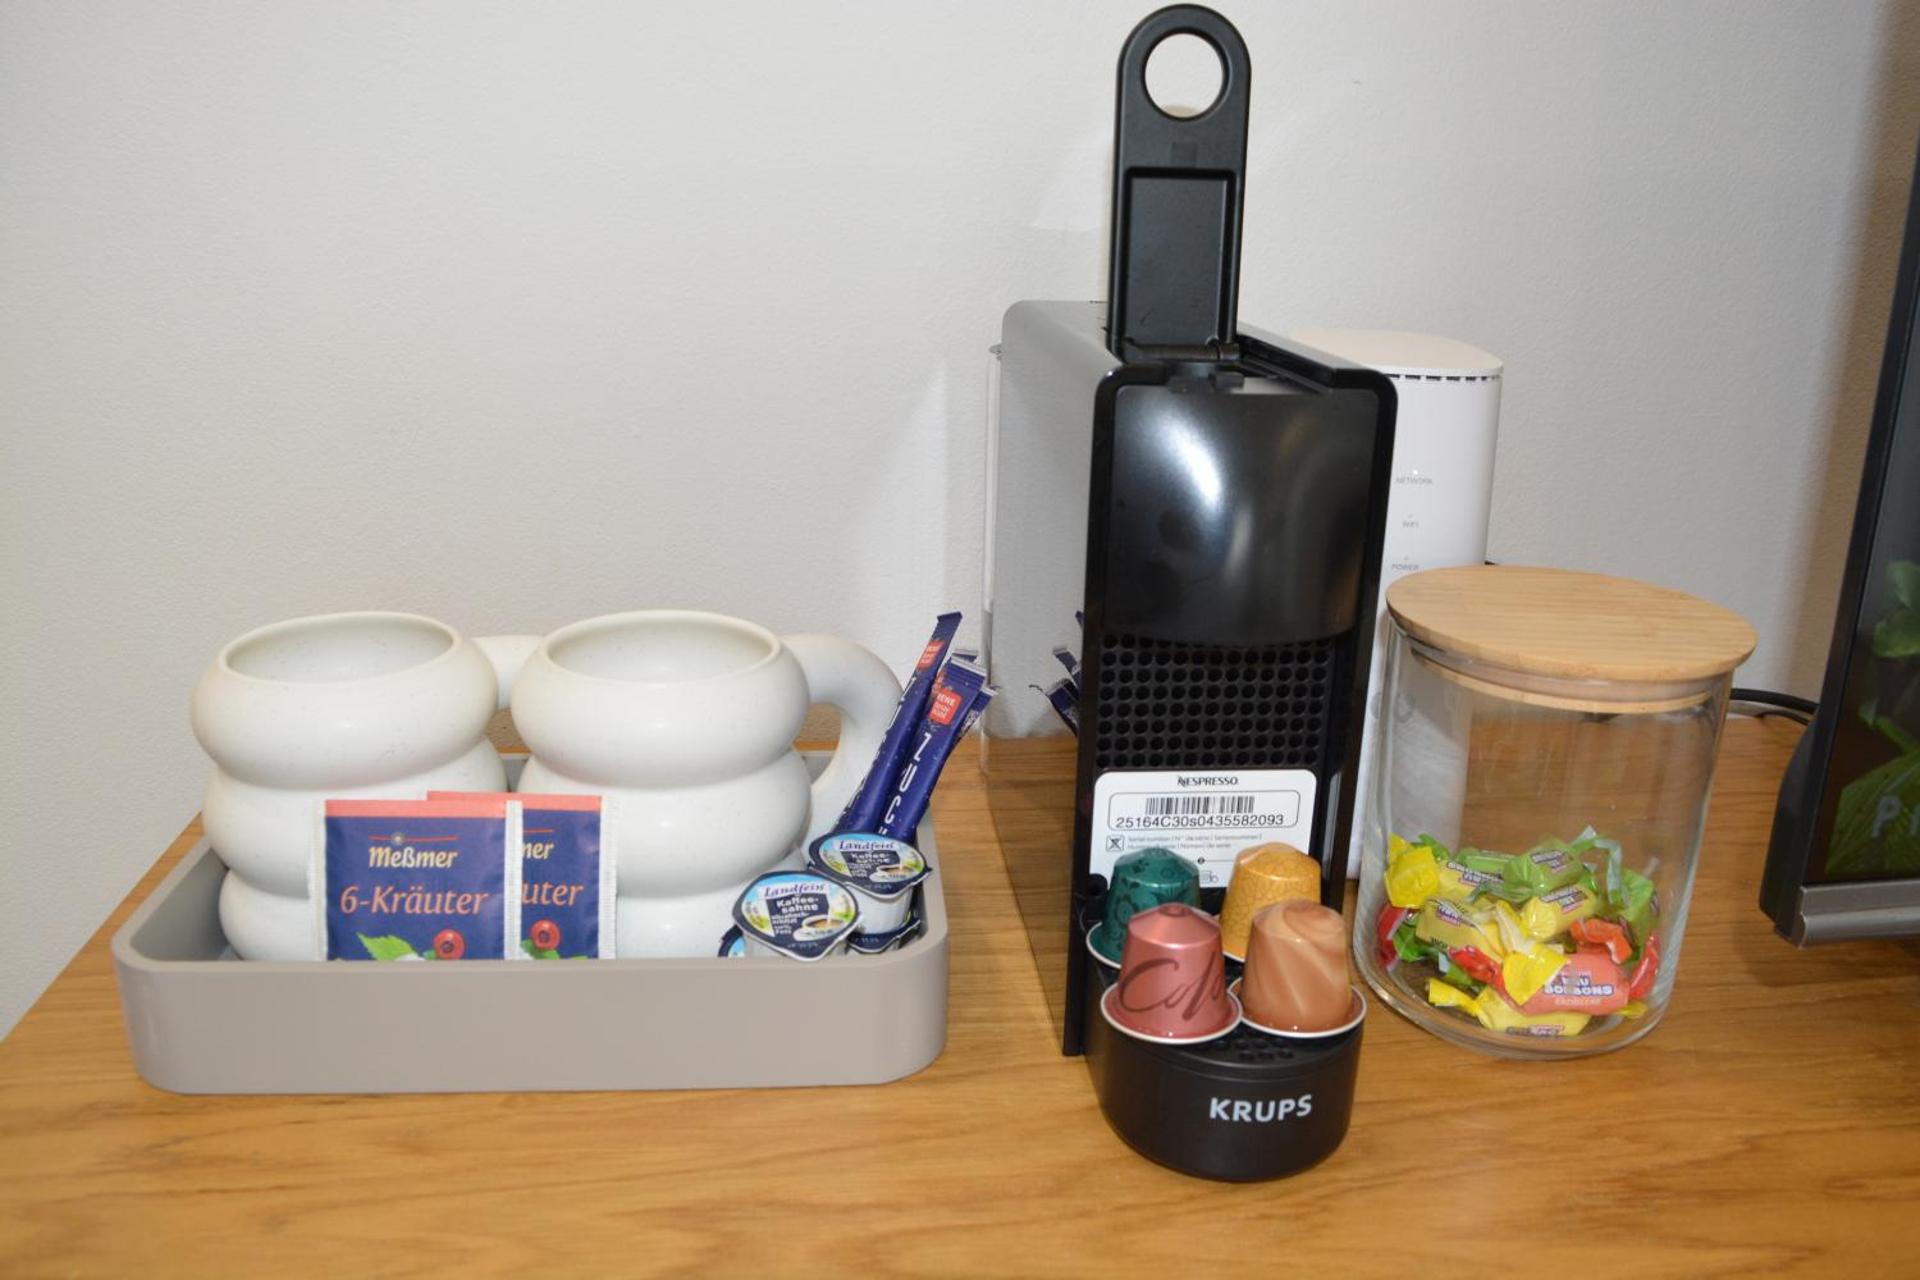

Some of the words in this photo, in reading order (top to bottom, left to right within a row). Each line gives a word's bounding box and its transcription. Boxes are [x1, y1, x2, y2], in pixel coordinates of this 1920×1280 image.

[1177, 776, 1239, 787] NESPRESSO
[1115, 814, 1285, 829] 25164C30s0435582093
[368, 846, 458, 868] Meßmer
[340, 886, 489, 914] 6-Kräuter
[781, 904, 819, 914] sahne
[1209, 1095, 1312, 1122] KRUPS
